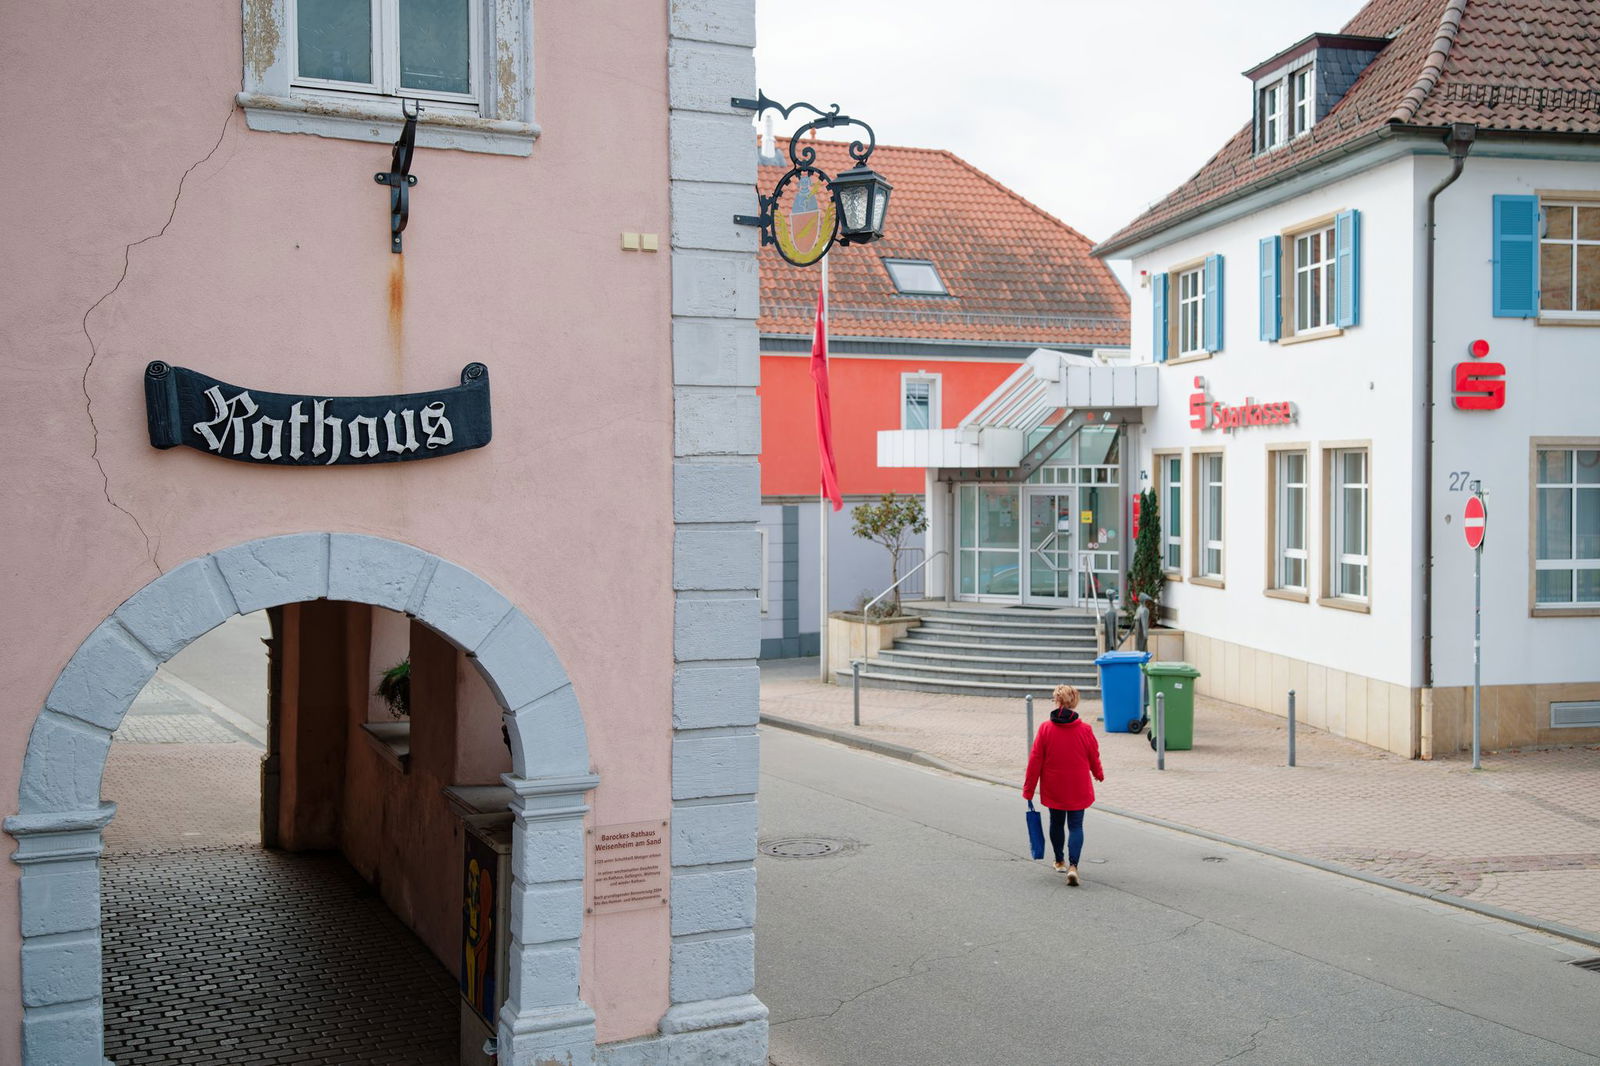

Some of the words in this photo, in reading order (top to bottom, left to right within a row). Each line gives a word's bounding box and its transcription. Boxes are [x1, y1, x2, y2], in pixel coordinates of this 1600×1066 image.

[193, 385, 454, 465] Rathaus
[1212, 397, 1292, 435] Sparkasse
[595, 841, 634, 851] Weisenheim
[646, 838, 662, 846] Sand
[601, 833, 630, 842] Barockes
[630, 830, 656, 838] Rathaus
